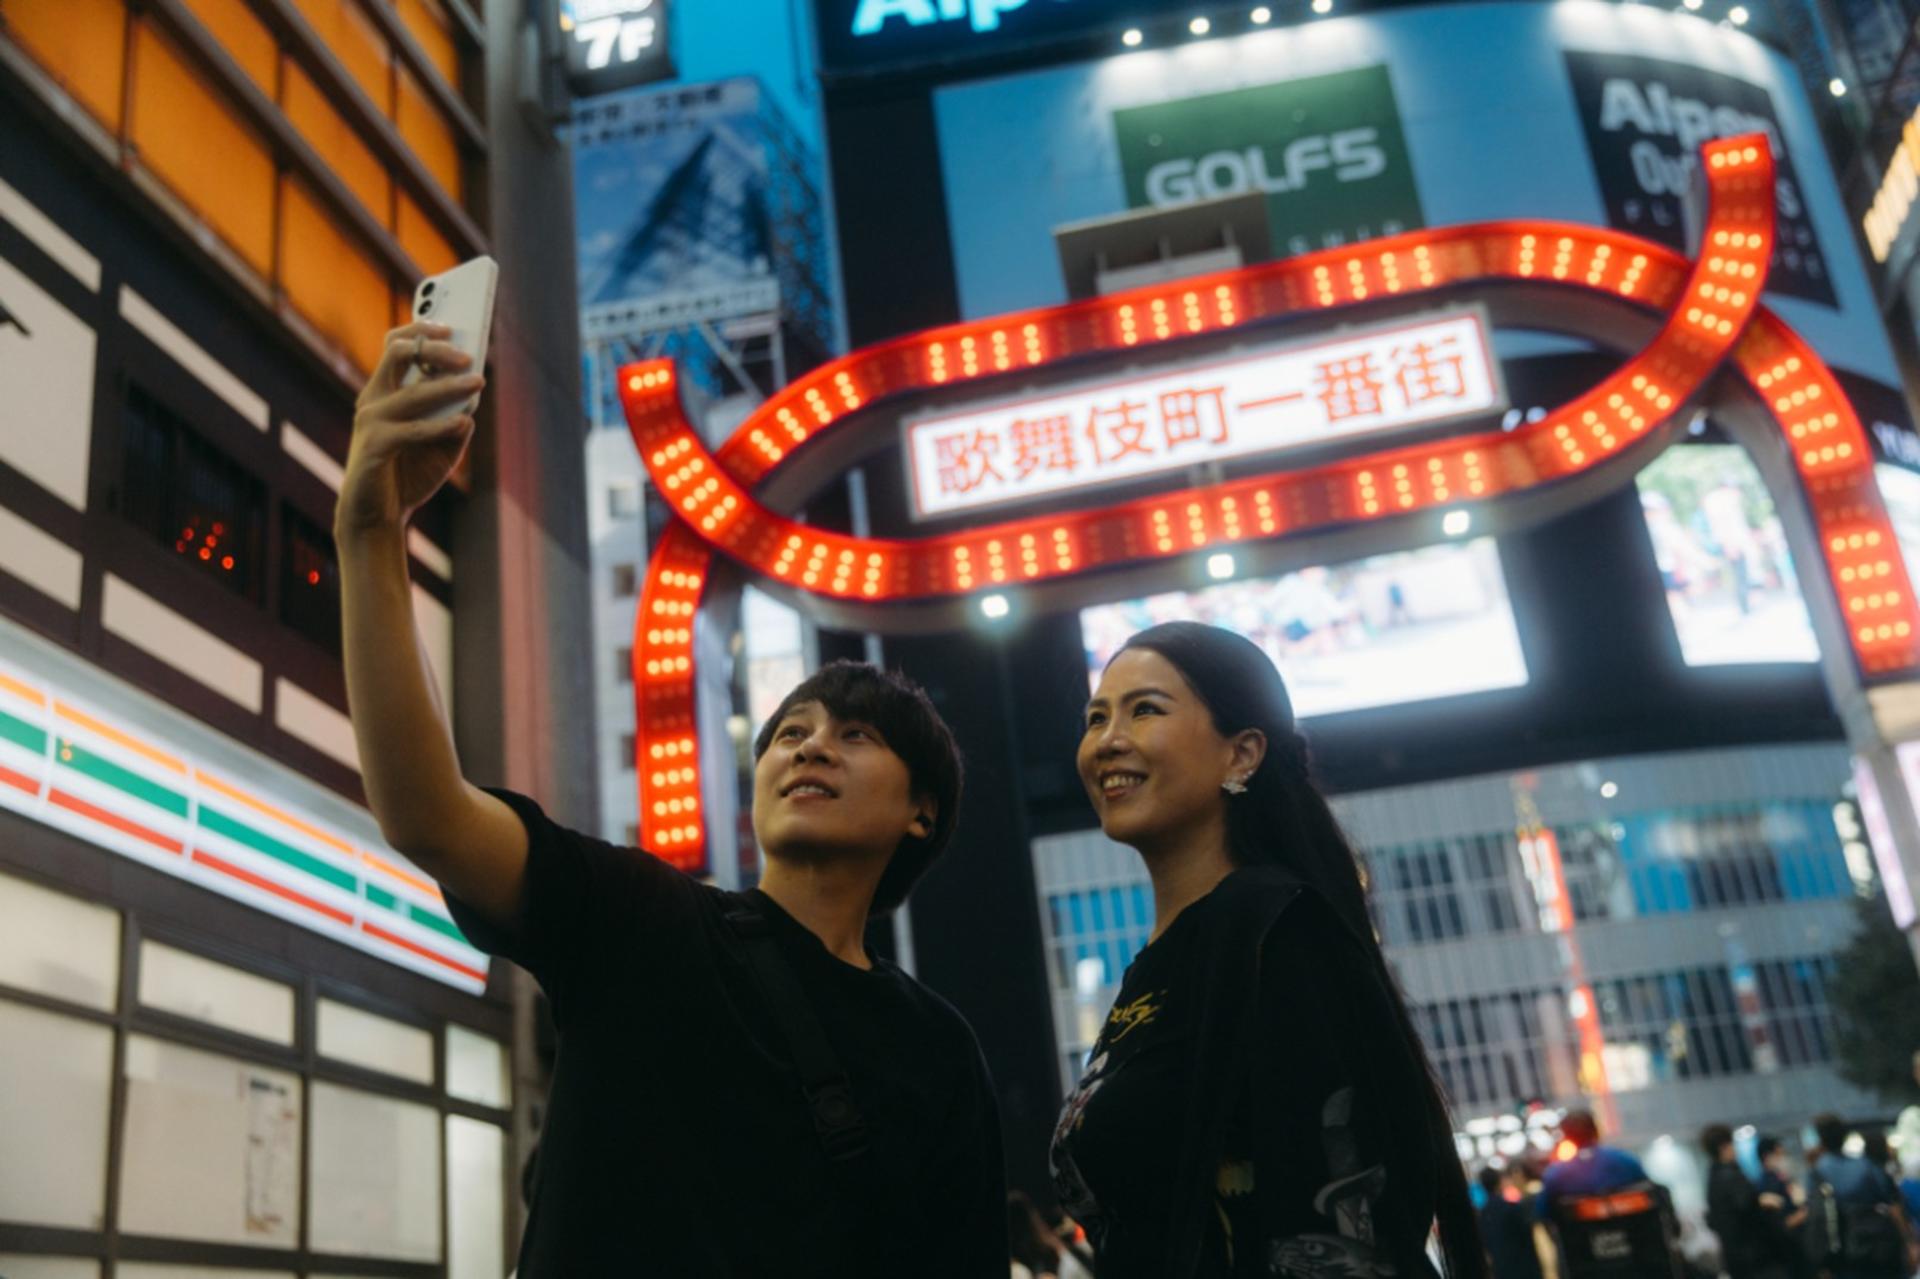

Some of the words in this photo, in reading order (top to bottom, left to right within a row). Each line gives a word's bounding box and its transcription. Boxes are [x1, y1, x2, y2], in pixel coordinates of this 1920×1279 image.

[575, 17, 655, 69] 7F
[1145, 126, 1387, 209] GOLF5
[931, 335, 1468, 494] 歌舞伎町一番街
